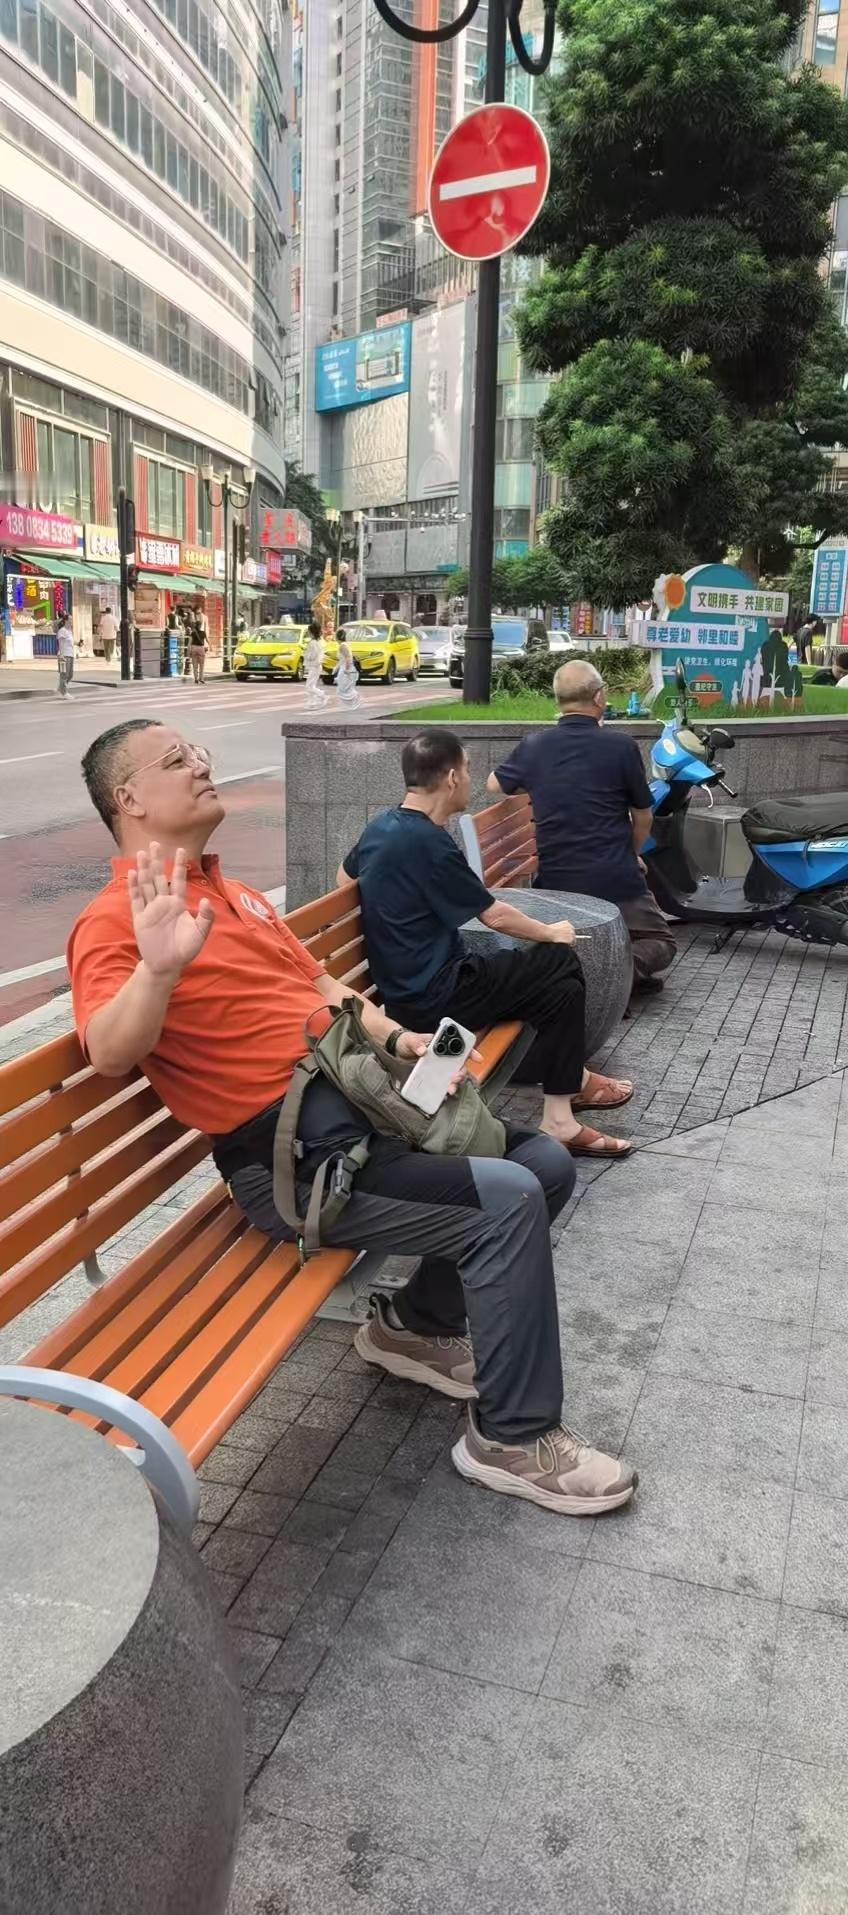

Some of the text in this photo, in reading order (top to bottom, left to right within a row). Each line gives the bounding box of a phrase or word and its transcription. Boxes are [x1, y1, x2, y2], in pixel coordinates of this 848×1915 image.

[6, 511, 24, 536] 138
[26, 515, 50, 540] 0834
[51, 521, 73, 545] 5339
[697, 592, 784, 612] 文明携手 共建家园
[646, 626, 739, 645] 尊老爱幼 邻里和睦
